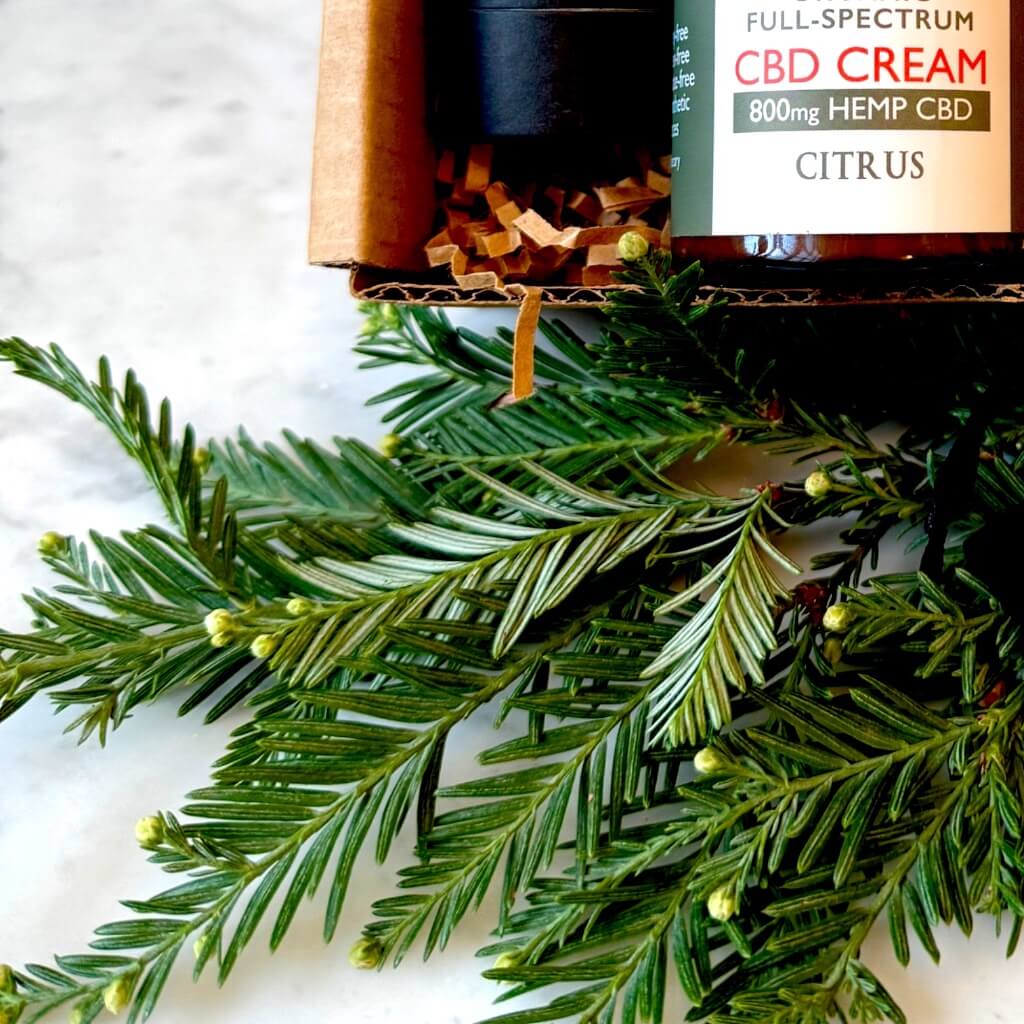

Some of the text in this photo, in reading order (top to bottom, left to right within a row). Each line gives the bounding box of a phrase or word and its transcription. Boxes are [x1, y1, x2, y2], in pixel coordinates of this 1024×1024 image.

[747, 8, 974, 32] FULL-SPECTRUM
[735, 47, 987, 85] CBD CREAM
[749, 96, 973, 126] 800mg HEMP CBD
[795, 150, 925, 180] CITRUS
